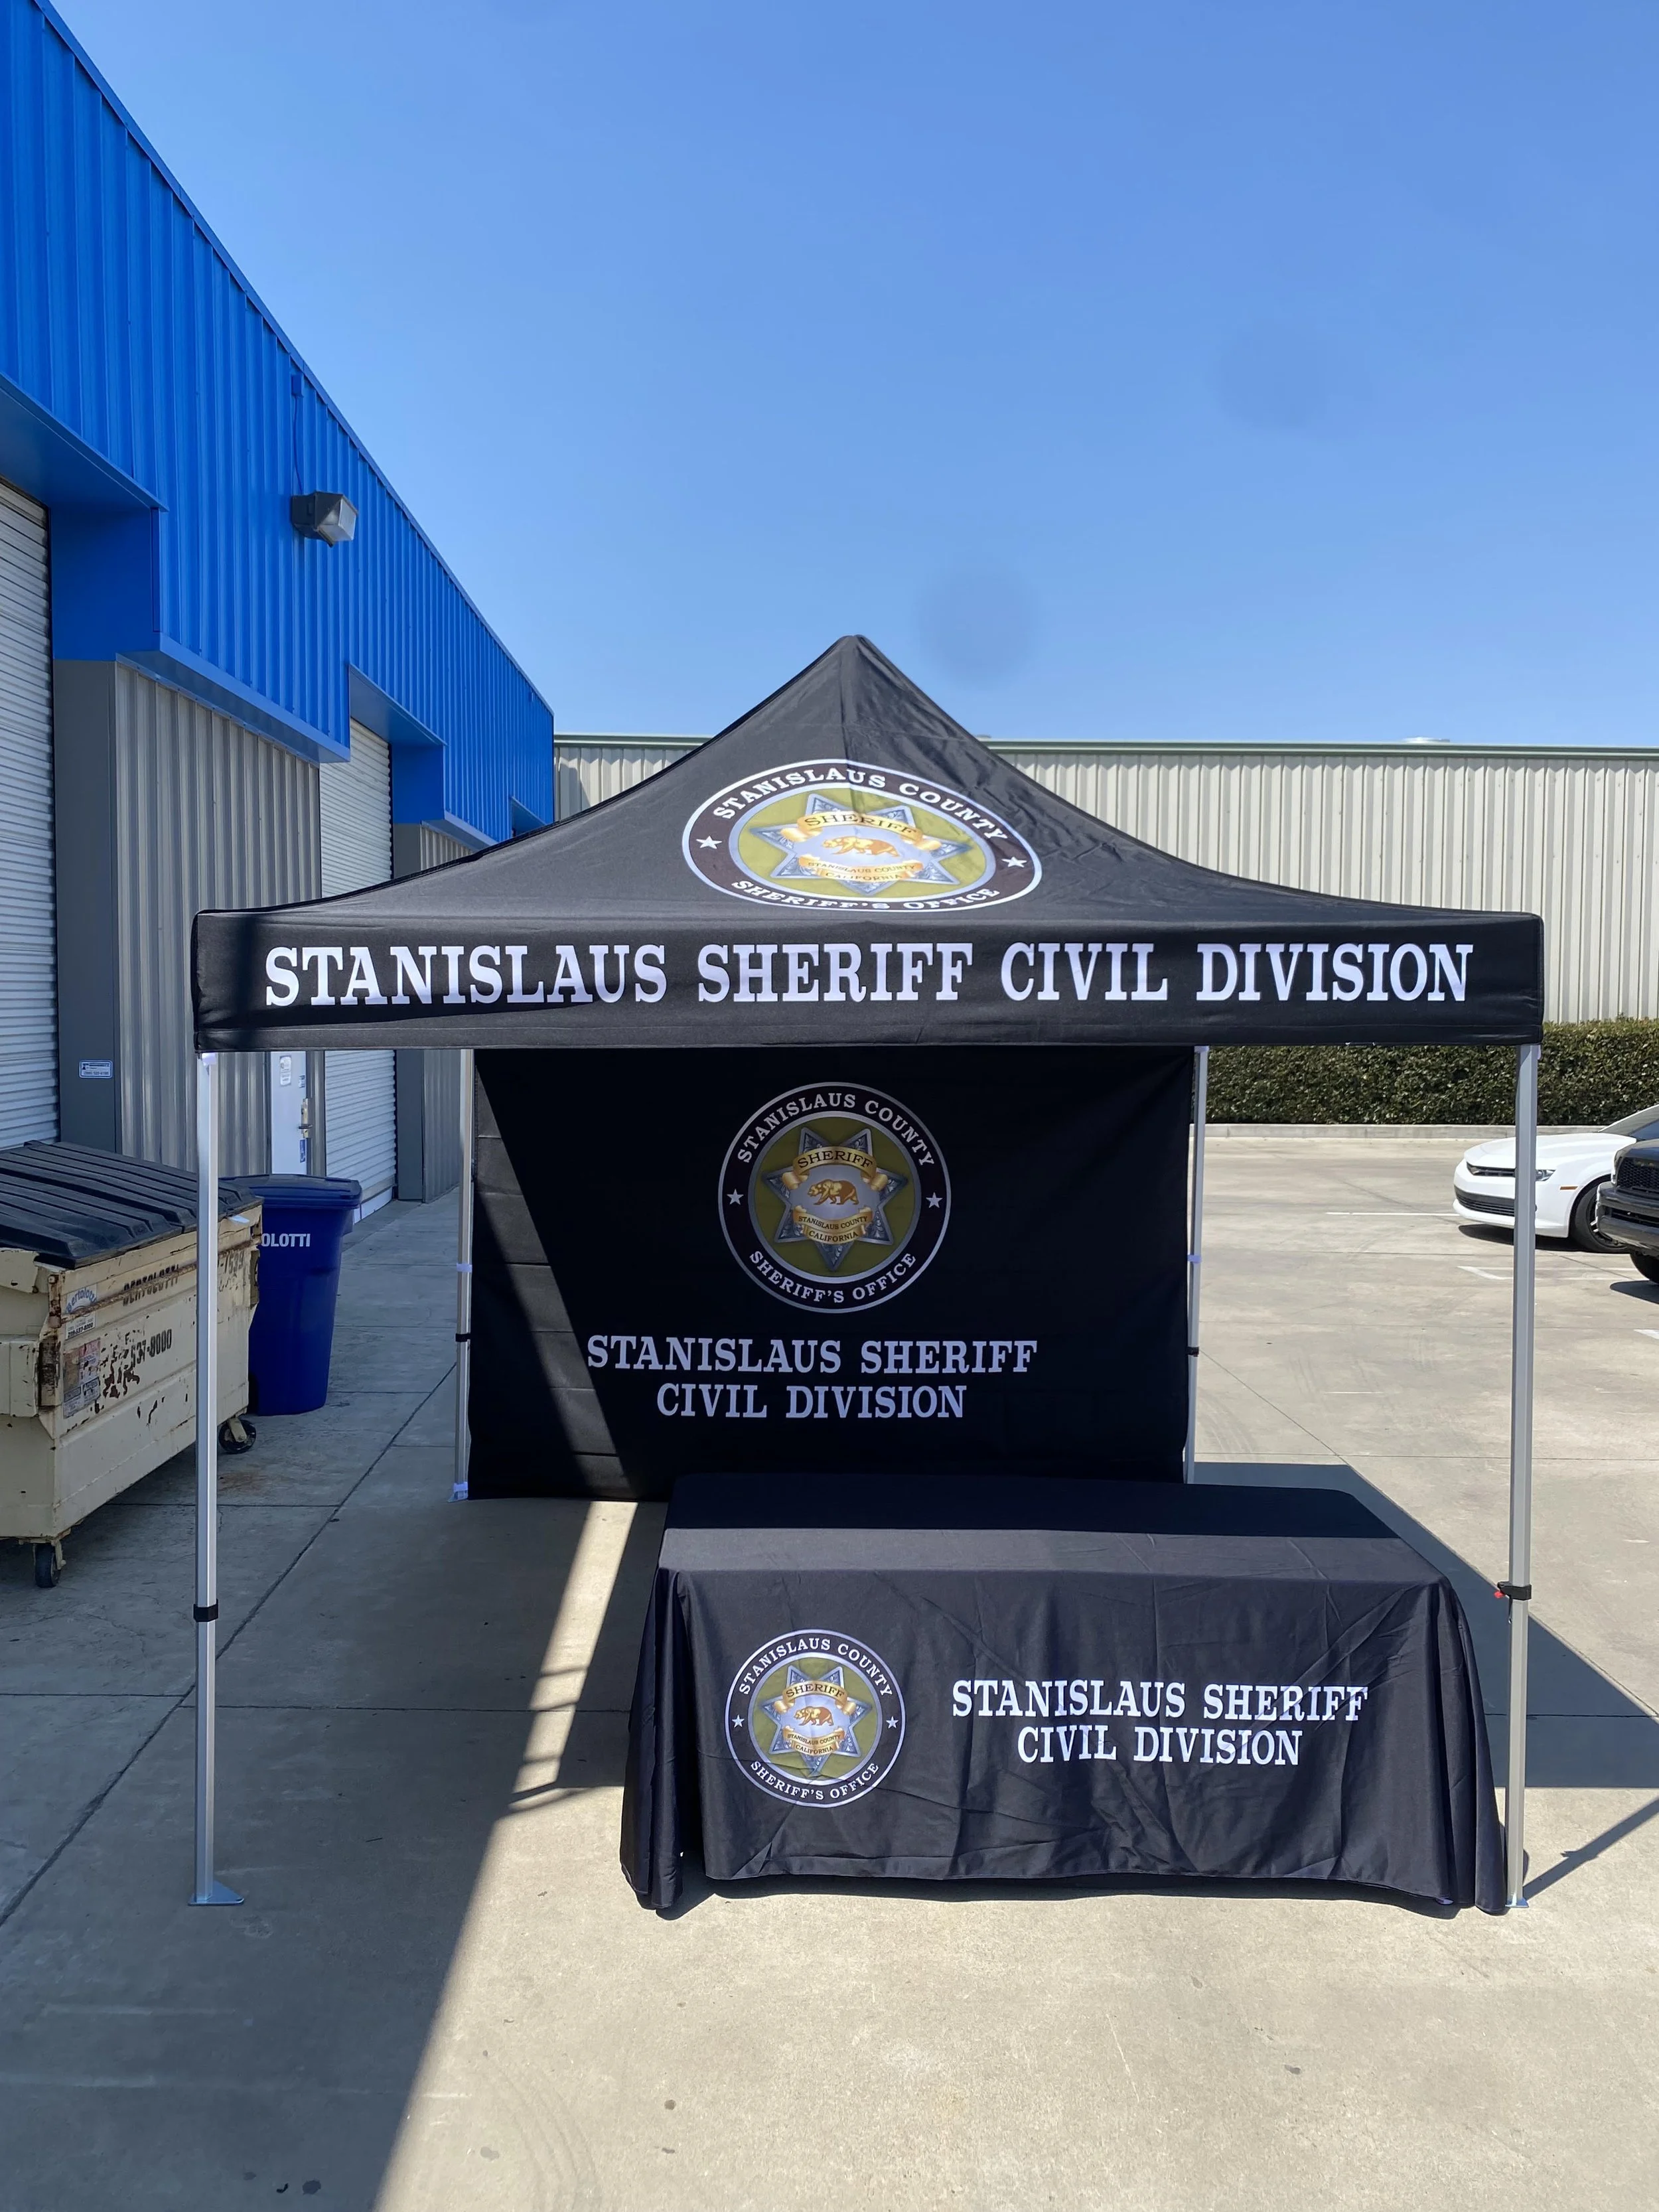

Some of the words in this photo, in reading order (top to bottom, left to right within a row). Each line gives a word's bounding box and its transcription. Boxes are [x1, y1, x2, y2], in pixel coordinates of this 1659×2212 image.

[714, 768, 886, 820] STANISLAUS
[899, 782, 1007, 841] COUNTY
[805, 814, 916, 834] SHERIFF
[808, 862, 871, 873] STANISLAUS
[874, 864, 915, 873] COUNTY
[826, 872, 903, 881] CALIFORNIA
[731, 879, 890, 909] SHERIFF'S
[903, 887, 1000, 910] OFFICE
[265, 944, 667, 1006] STANISLAUS
[697, 942, 973, 1003] SHERIFF
[1001, 942, 1168, 1001] CIVIL
[1196, 943, 1473, 1001] DIVISION
[737, 1093, 856, 1163] STANISLAUS
[865, 1100, 934, 1166] COUNTY
[798, 1150, 873, 1169] SHERIFF
[798, 1216, 839, 1230] STANISLAUS
[840, 1216, 868, 1229] COUNTY
[808, 1230, 859, 1242] CALIFORNIA
[749, 1250, 844, 1303] SHERIFF'S
[852, 1253, 916, 1300] OFFICE
[587, 1335, 841, 1373] STANISLAUS
[861, 1340, 1037, 1374] SHERIFF
[657, 1382, 767, 1418] CIVIL
[786, 1385, 967, 1418] DIVISION
[739, 1638, 830, 1695] STANISLAUS
[837, 1643, 893, 1697] COUNTY
[786, 1683, 844, 1698] SHERIFF
[952, 1679, 1186, 1718] STANISLAUS
[1203, 1684, 1368, 1722] SHERIFF
[787, 1733, 819, 1745] STANISLAUS
[820, 1733, 841, 1744] COUNTY
[796, 1744, 833, 1755] CALIFORNIA
[1017, 1725, 1117, 1763] CIVIL
[1133, 1726, 1303, 1765] DIVISION
[751, 1761, 824, 1800] SHERIFF'S
[830, 1763, 879, 1799] OFFICE
